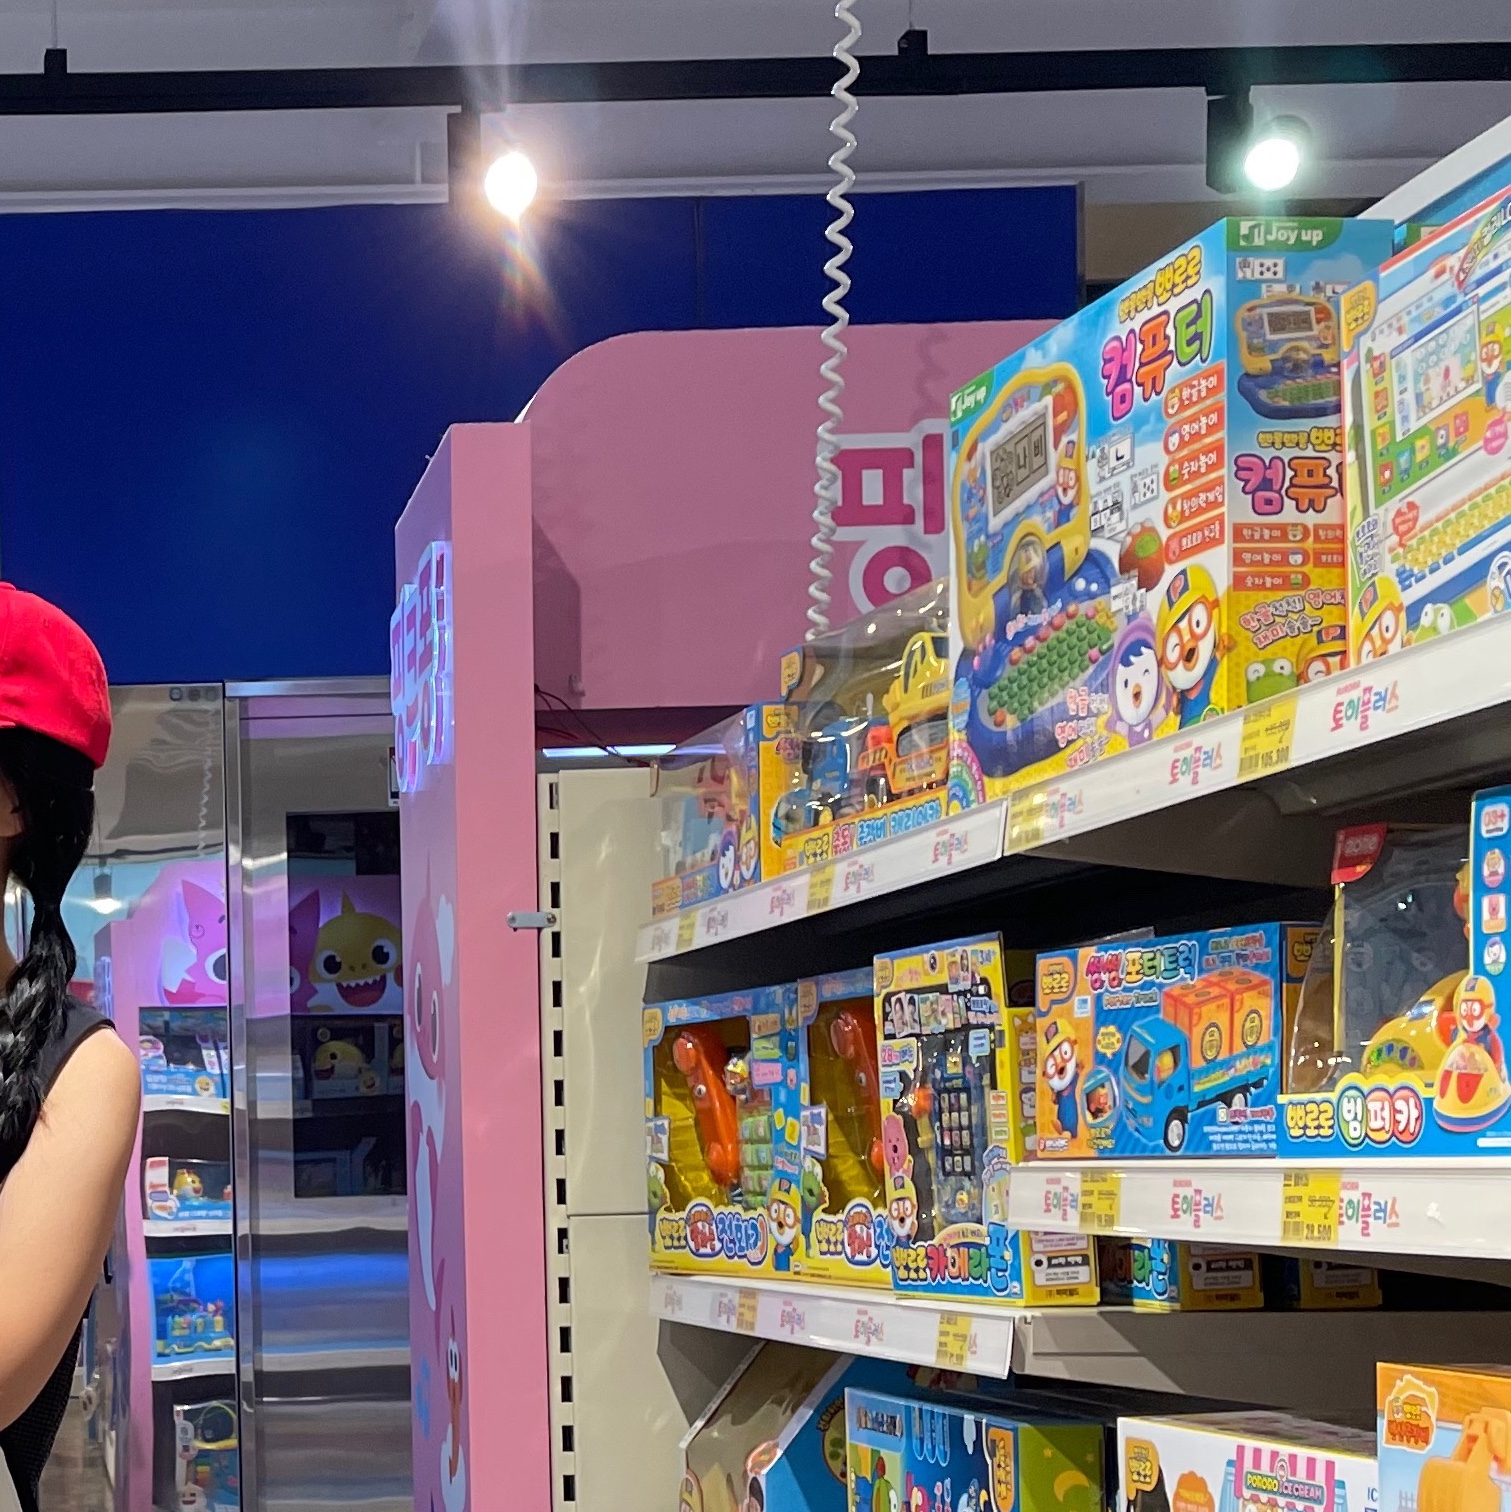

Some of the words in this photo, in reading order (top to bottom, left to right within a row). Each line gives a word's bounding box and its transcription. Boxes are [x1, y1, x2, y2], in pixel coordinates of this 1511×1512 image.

[1267, 226, 1298, 245] Joy
[1302, 230, 1323, 246] up
[1154, 245, 1202, 305] 뽀로로
[1101, 289, 1214, 421] 컴퓨터
[1181, 377, 1218, 405] 한글놀이
[1181, 411, 1218, 442] 영어놀이
[1181, 451, 1218, 480] 숫자놀이
[1234, 454, 1344, 515] 컴퓨
[1331, 680, 1400, 732] 토이플러스
[1168, 742, 1223, 786] 토이플러스
[1086, 952, 1123, 990] 씽씽
[1125, 942, 1198, 984] 포터트럭
[1287, 1101, 1335, 1138] 뽀로로
[1044, 1186, 1079, 1222] 토이플러
[1171, 1187, 1224, 1229] 토이플러스
[893, 1247, 927, 1281] 뽀로로
[927, 1221, 1011, 1296] 카메라폰
[1246, 1473, 1279, 1492] PORORO
